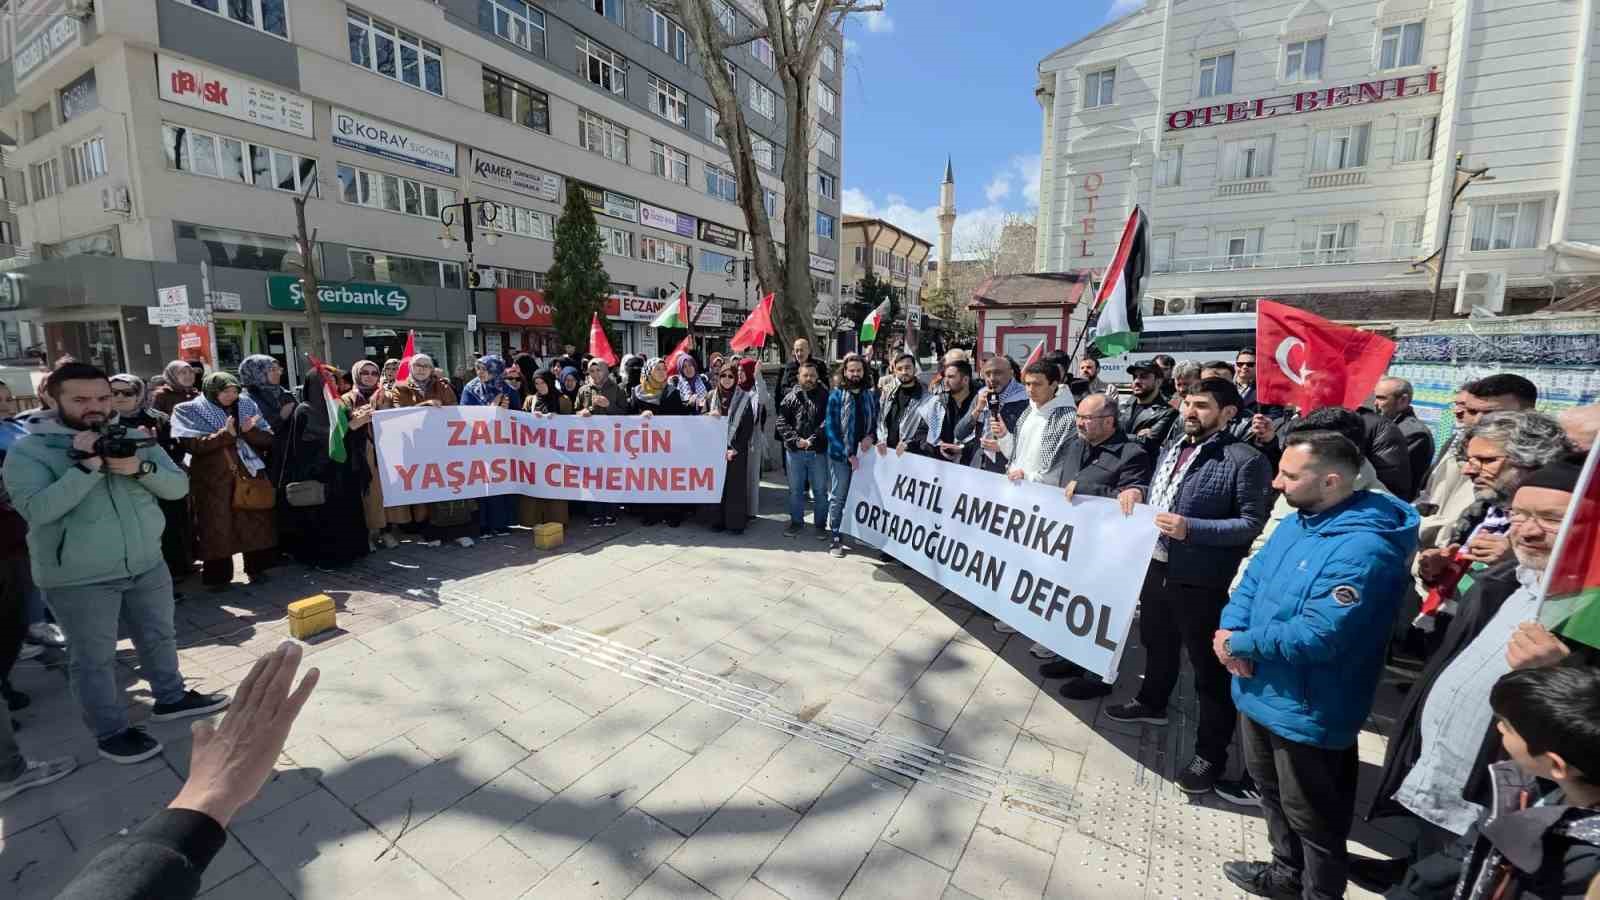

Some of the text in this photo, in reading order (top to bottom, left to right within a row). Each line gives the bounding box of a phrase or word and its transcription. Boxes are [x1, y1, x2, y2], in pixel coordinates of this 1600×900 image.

[1168, 65, 1441, 129] OTEL BENLİ
[356, 122, 408, 149] KORAY
[474, 157, 513, 179] KAMER
[289, 283, 385, 305] Şkerbank
[447, 416, 673, 460] ZALİMLER İÇİN
[394, 458, 715, 494] YAŞASIN CEHENNEM
[891, 474, 1075, 562] KATİL AMERİKA
[855, 501, 1119, 652] ORTADOĞUDAN DEFOL
